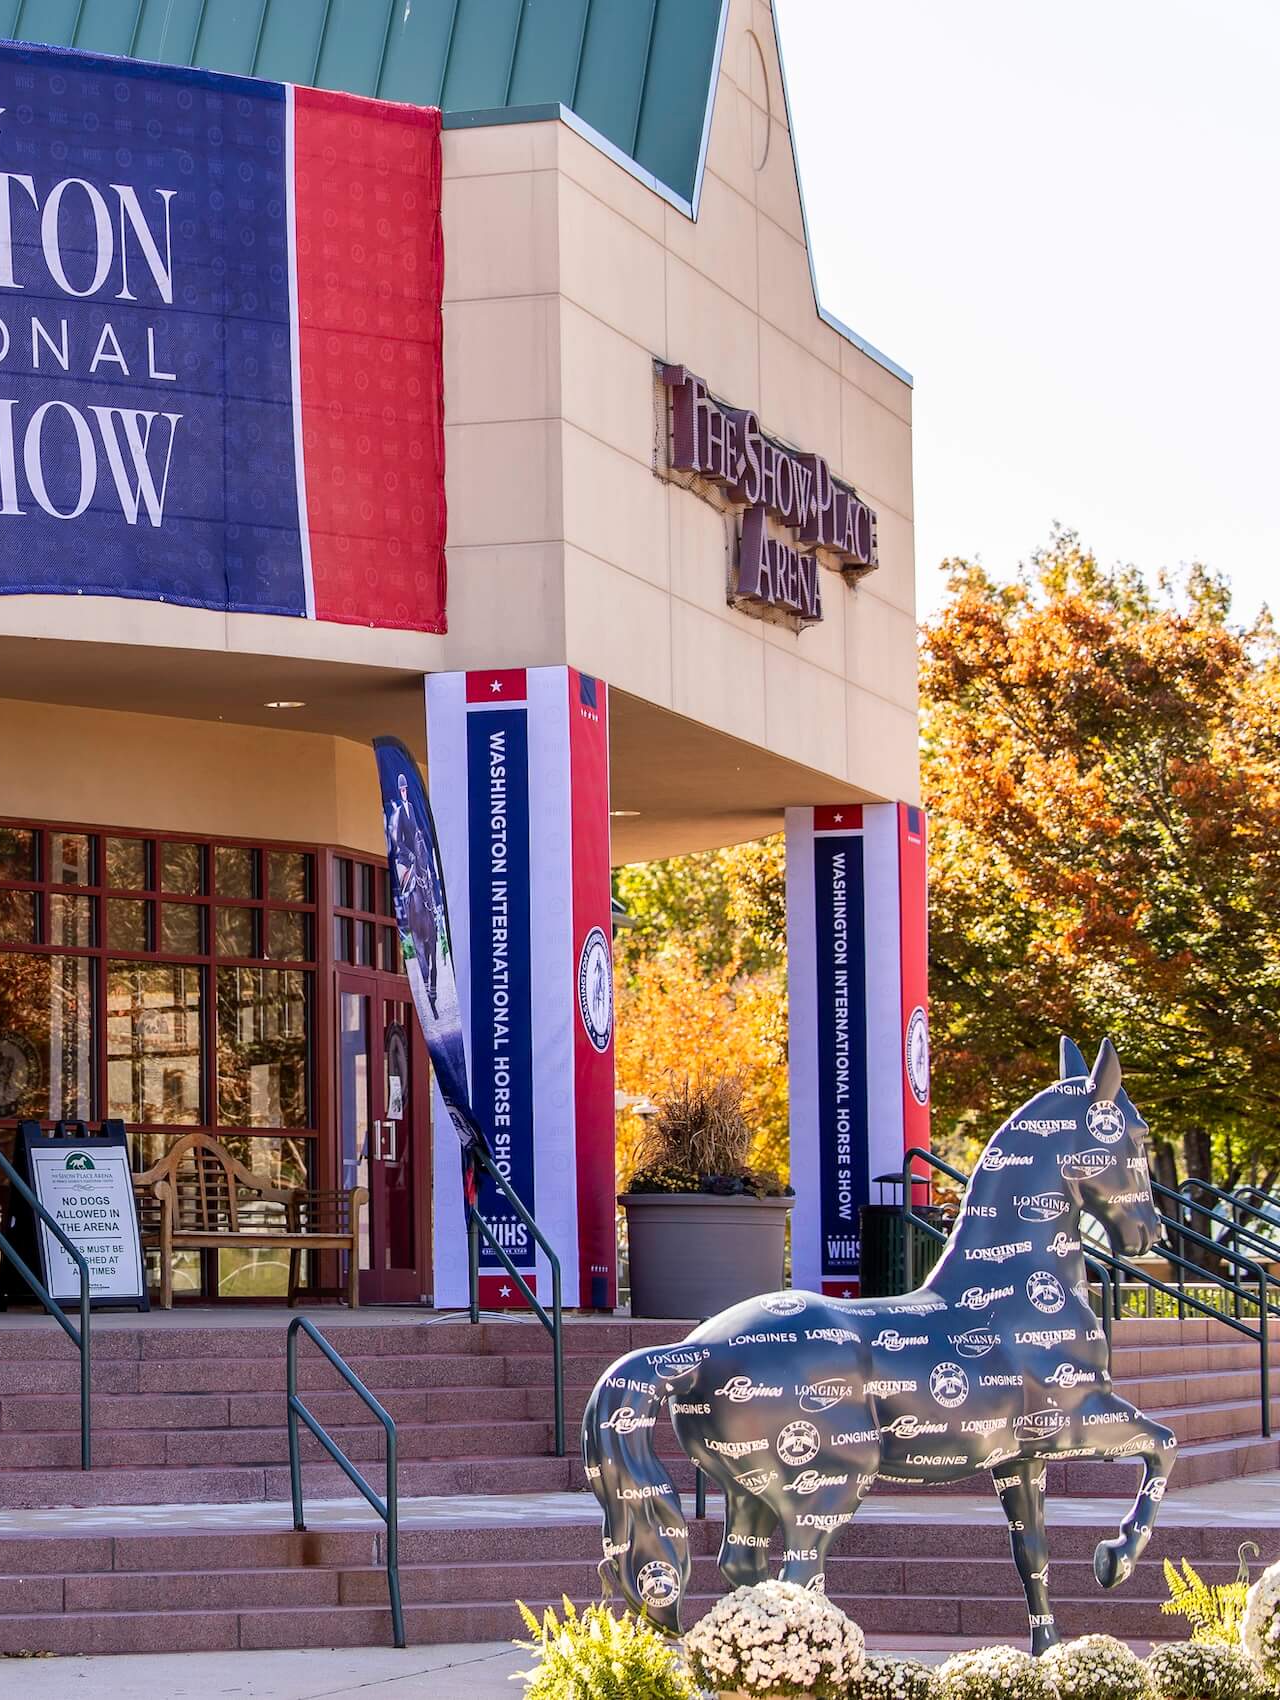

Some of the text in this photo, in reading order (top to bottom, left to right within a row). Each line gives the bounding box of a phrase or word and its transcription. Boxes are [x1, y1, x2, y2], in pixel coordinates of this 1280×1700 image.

[743, 411, 813, 527] SHOW
[489, 730, 506, 874] WASHINGTON
[491, 880, 510, 1050] INTERNATIONAL
[832, 852, 852, 1220] WASHINGTON INTERNATIONAL HORSE SHOW
[494, 1056, 511, 1126] HORSE
[1010, 1120, 1077, 1131] LONGINES
[1056, 1153, 1117, 1166] LONGINES
[62, 1196, 110, 1206] NO DOGS
[1013, 1196, 1070, 1212] LONGINES
[1108, 1191, 1150, 1204] LONGINES
[56, 1209, 120, 1219] ALLOWED IN
[61, 1222, 120, 1232] THE ARENA
[481, 1222, 528, 1246] WIHS
[60, 1245, 85, 1254] DS
[965, 1241, 1032, 1260] LONGINES
[67, 1257, 107, 1265] LESHED
[91, 1267, 116, 1275] TIMES
[955, 1284, 1014, 1310] Longines
[888, 1302, 948, 1314] LONGINES
[728, 1332, 797, 1346] LONGINES
[804, 1328, 861, 1343] LONGINES
[871, 1329, 929, 1351] Longines
[947, 1334, 1001, 1345] LONGINES
[1015, 1329, 1076, 1343] LONGINES
[646, 1348, 710, 1365] LONGINES
[979, 1375, 1023, 1387] LONGINES
[1045, 1362, 1096, 1388] Longines
[714, 1375, 784, 1402] Longines
[794, 1384, 852, 1397] LONGINES
[961, 1418, 1007, 1432] LONGINES
[1013, 1415, 1070, 1427] LONGINES
[1082, 1411, 1130, 1425] LONGINES
[881, 1414, 948, 1439] Longines
[704, 1438, 769, 1451] LONGINES
[831, 1429, 880, 1446] LONGINES
[1034, 1447, 1096, 1460] LONGINES
[1104, 1438, 1155, 1457] LONGINES
[906, 1453, 968, 1466] LONGINES
[782, 1469, 848, 1494] Longines
[616, 1483, 673, 1499] LONGINE
